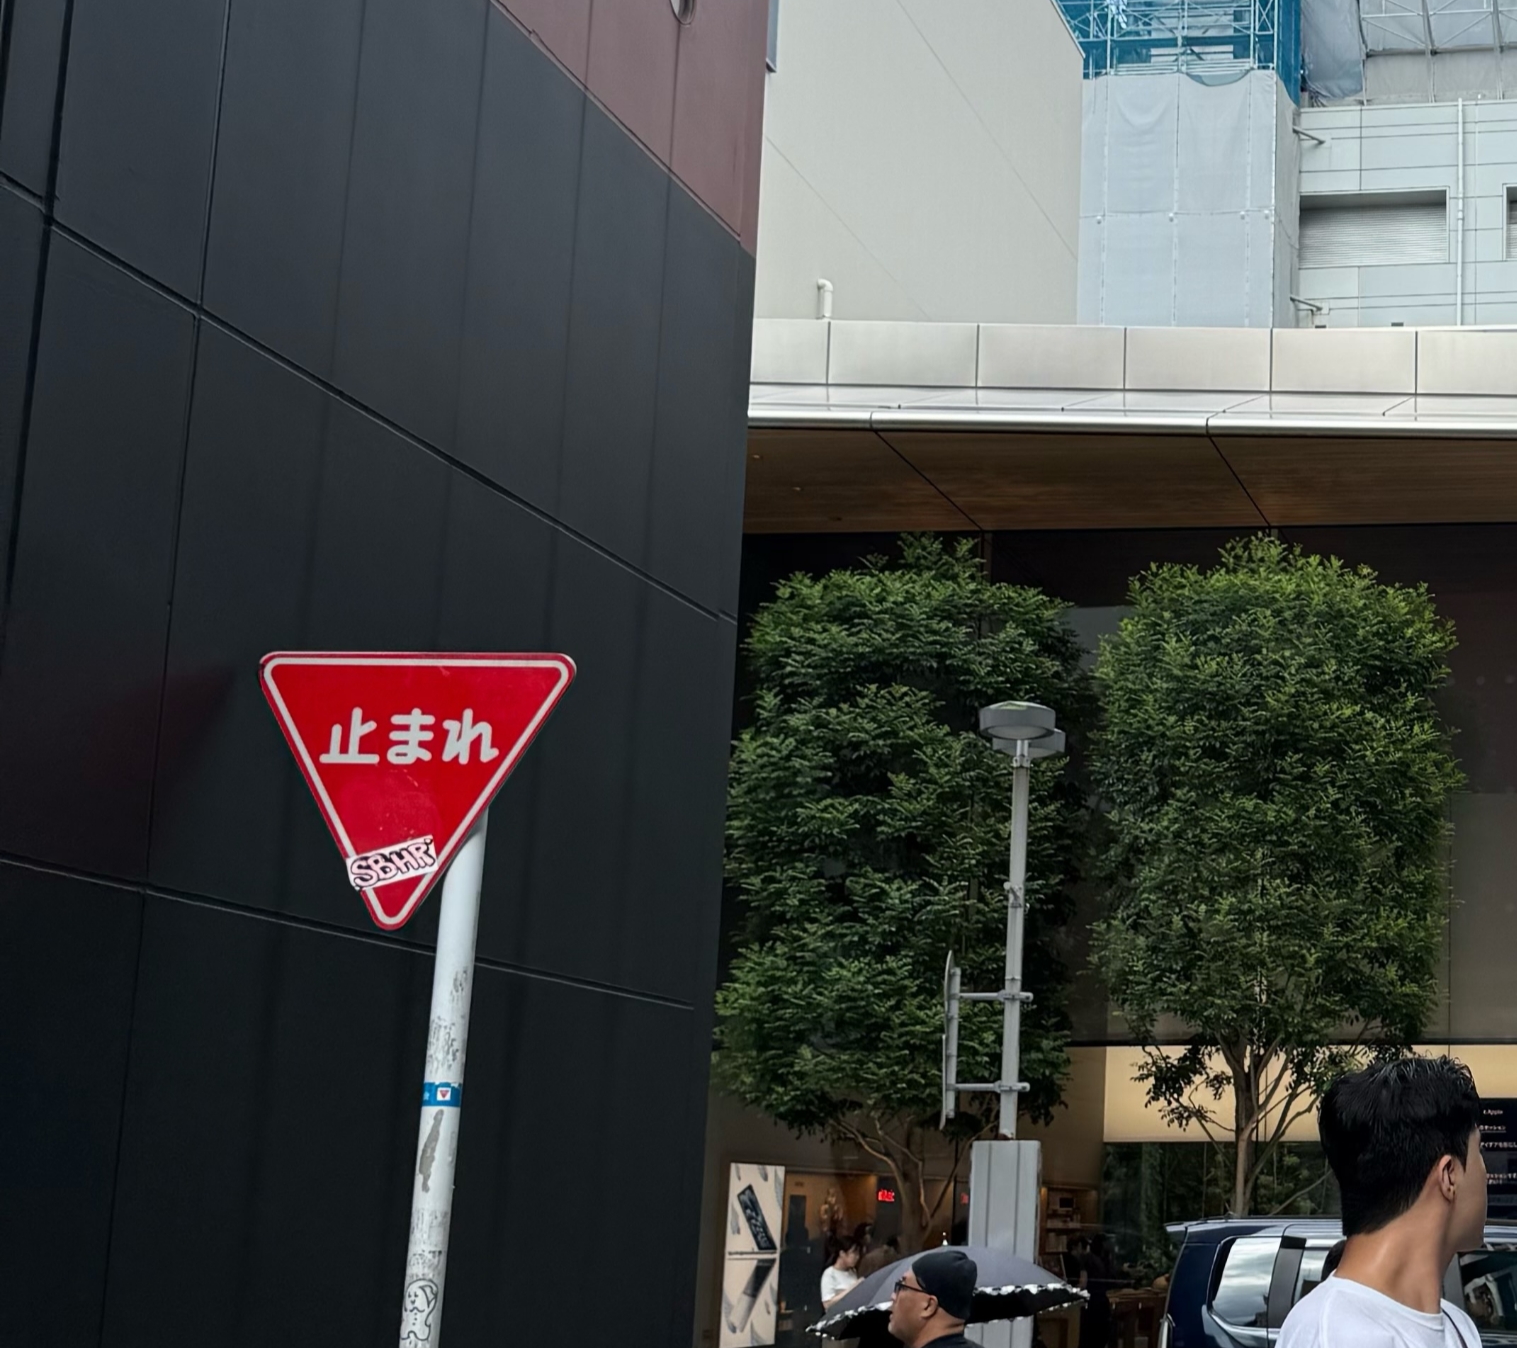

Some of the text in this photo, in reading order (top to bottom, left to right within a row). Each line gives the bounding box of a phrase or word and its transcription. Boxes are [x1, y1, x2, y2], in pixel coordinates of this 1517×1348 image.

[319, 707, 499, 765] 止まれ
[350, 842, 436, 888] SBHR
